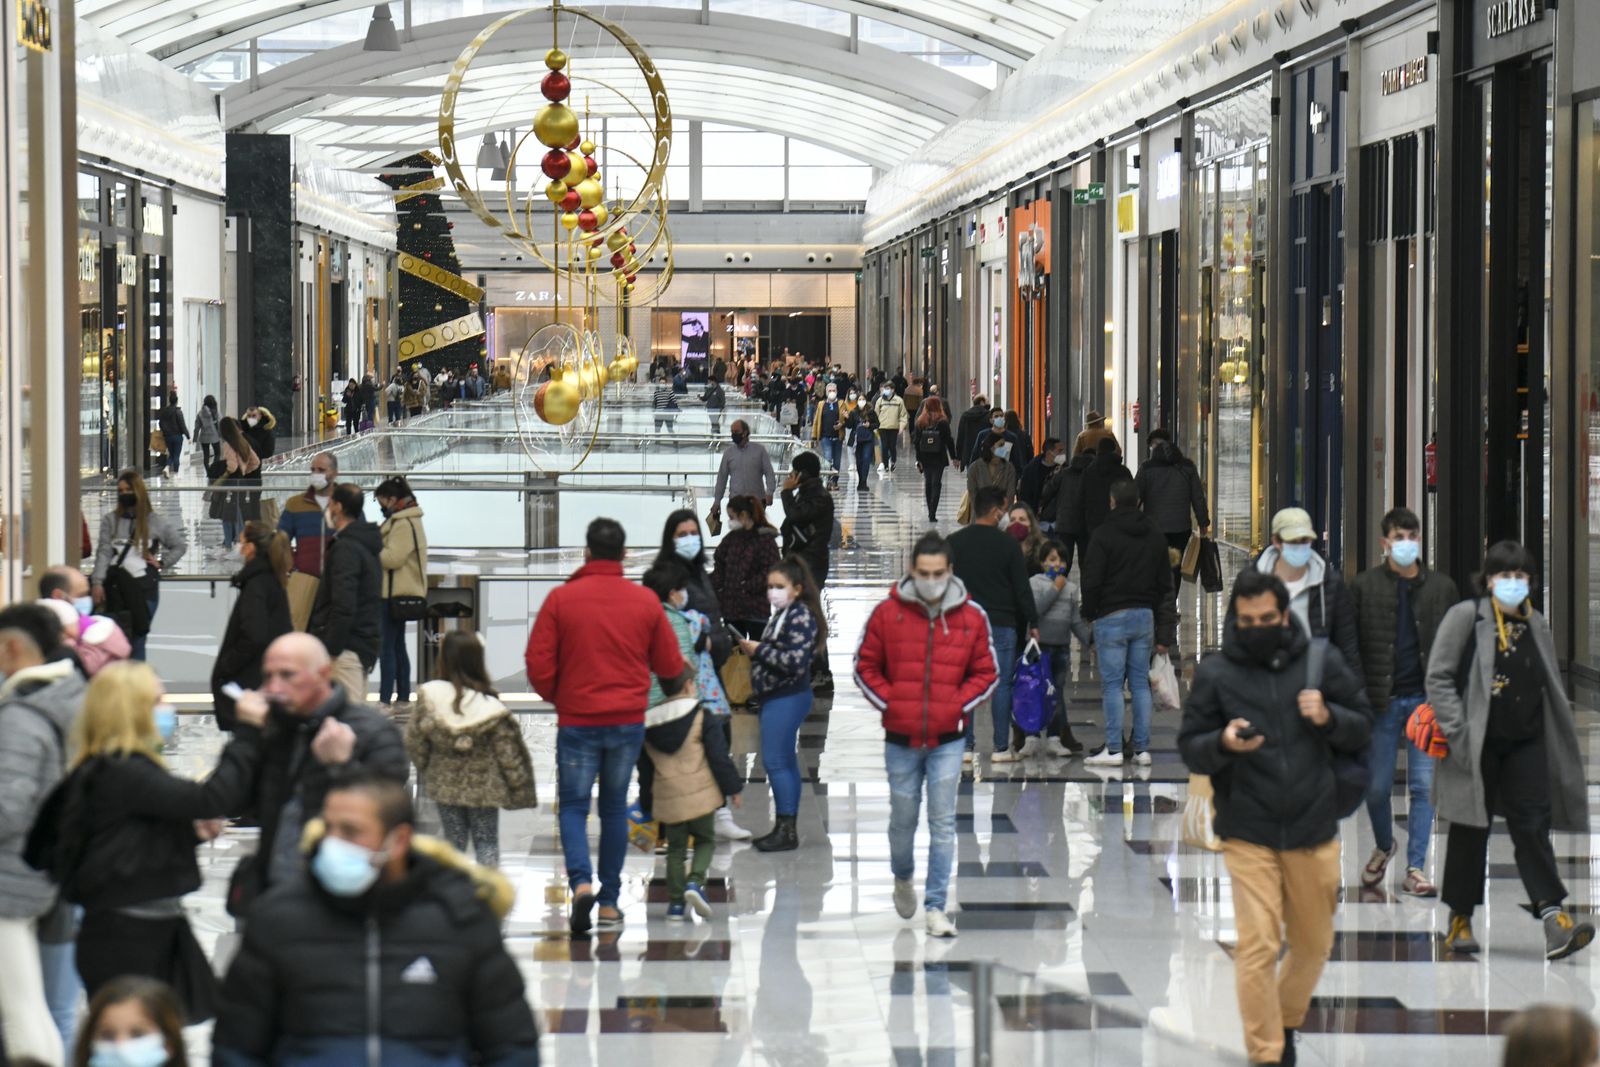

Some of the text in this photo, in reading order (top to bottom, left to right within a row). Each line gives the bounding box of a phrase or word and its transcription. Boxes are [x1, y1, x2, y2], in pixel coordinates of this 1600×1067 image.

[1487, 0, 1529, 40] SCALPERS
[515, 290, 563, 301] ZARA
[726, 324, 758, 332] ZARA
